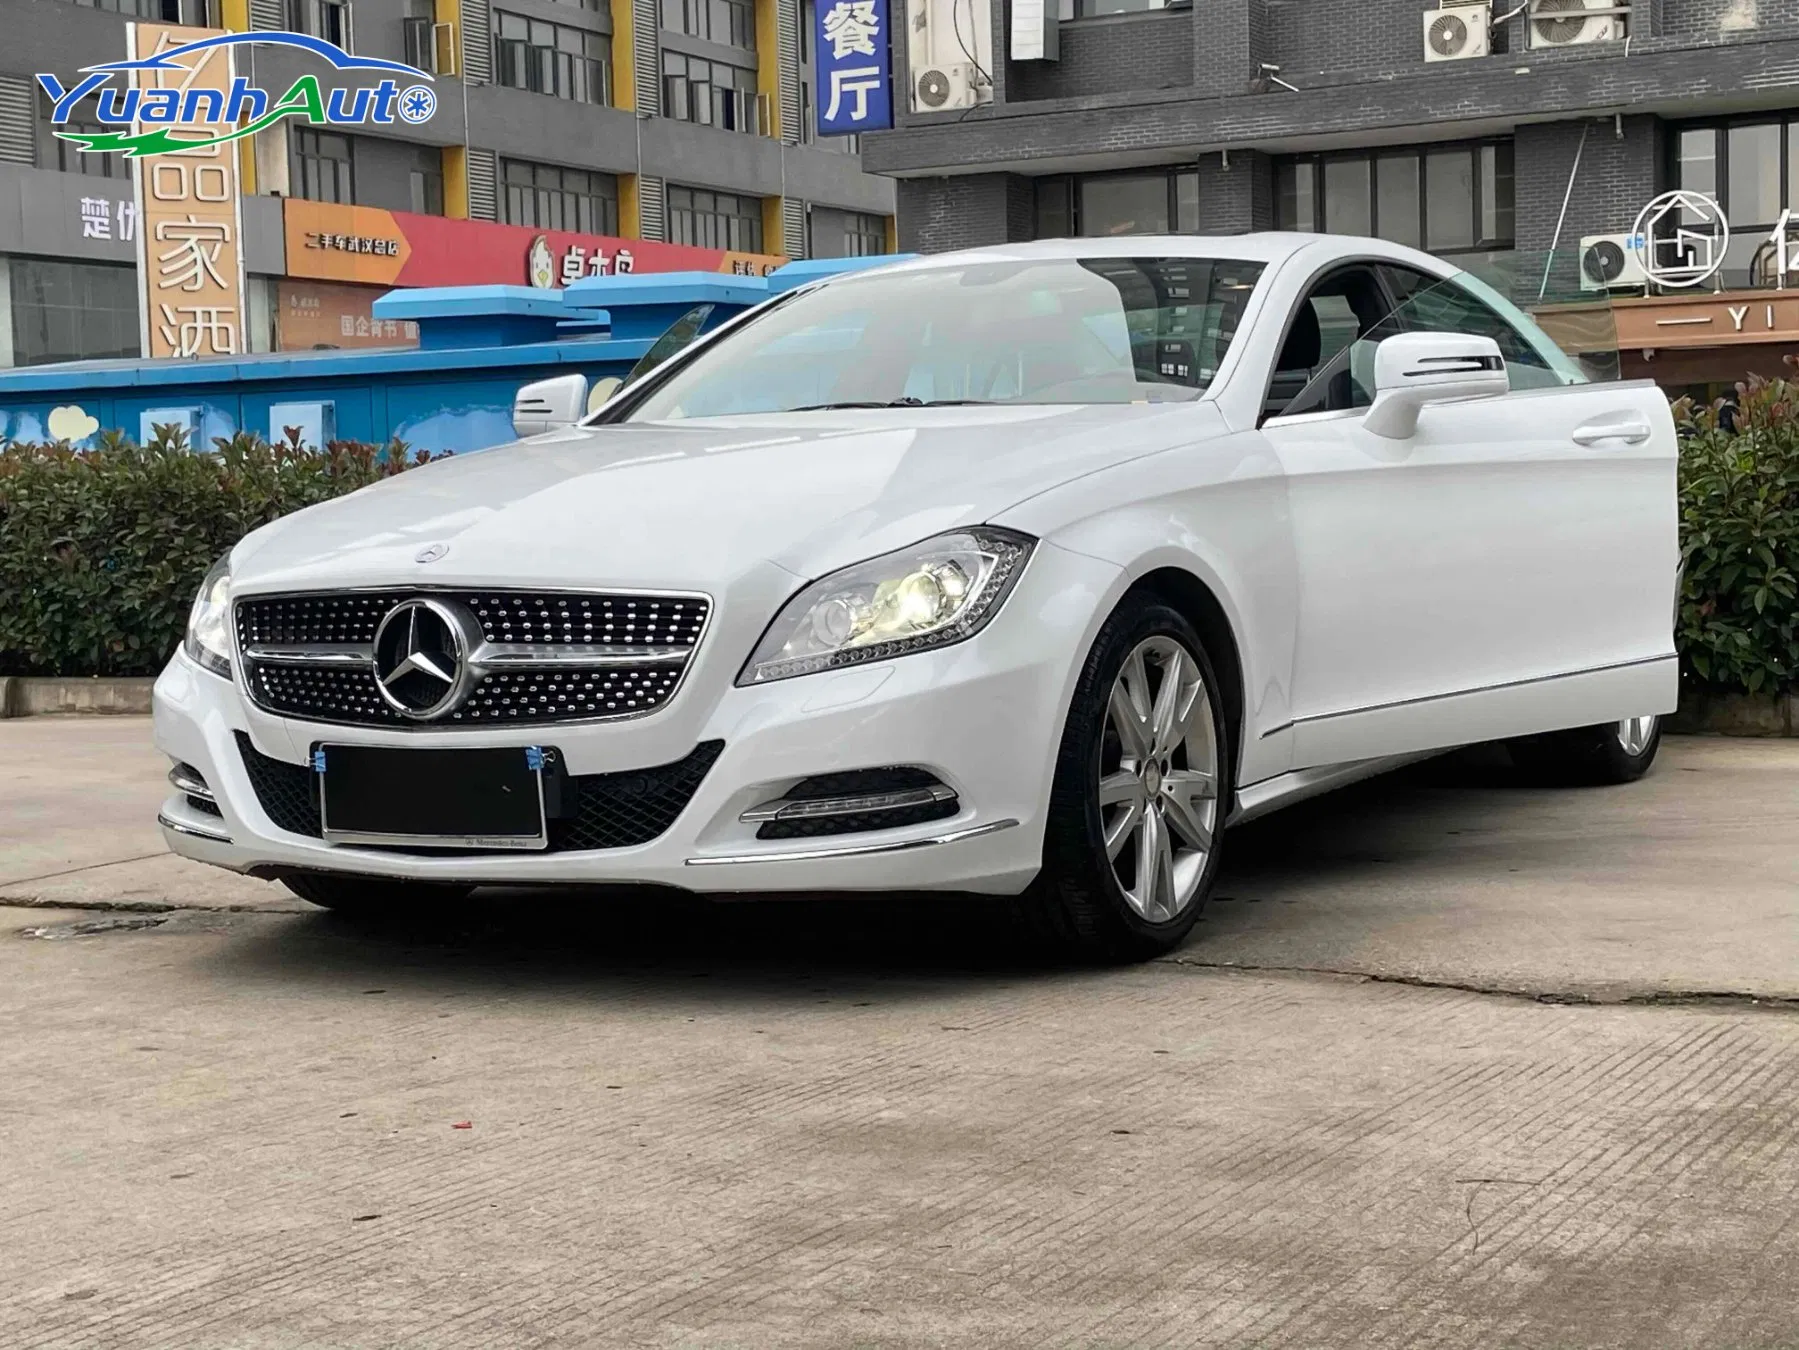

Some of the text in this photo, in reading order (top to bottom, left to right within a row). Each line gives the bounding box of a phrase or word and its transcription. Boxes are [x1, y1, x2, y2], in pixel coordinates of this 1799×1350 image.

[823, 1, 880, 121] 餐厅
[304, 232, 400, 256] 二手车武汉总店
